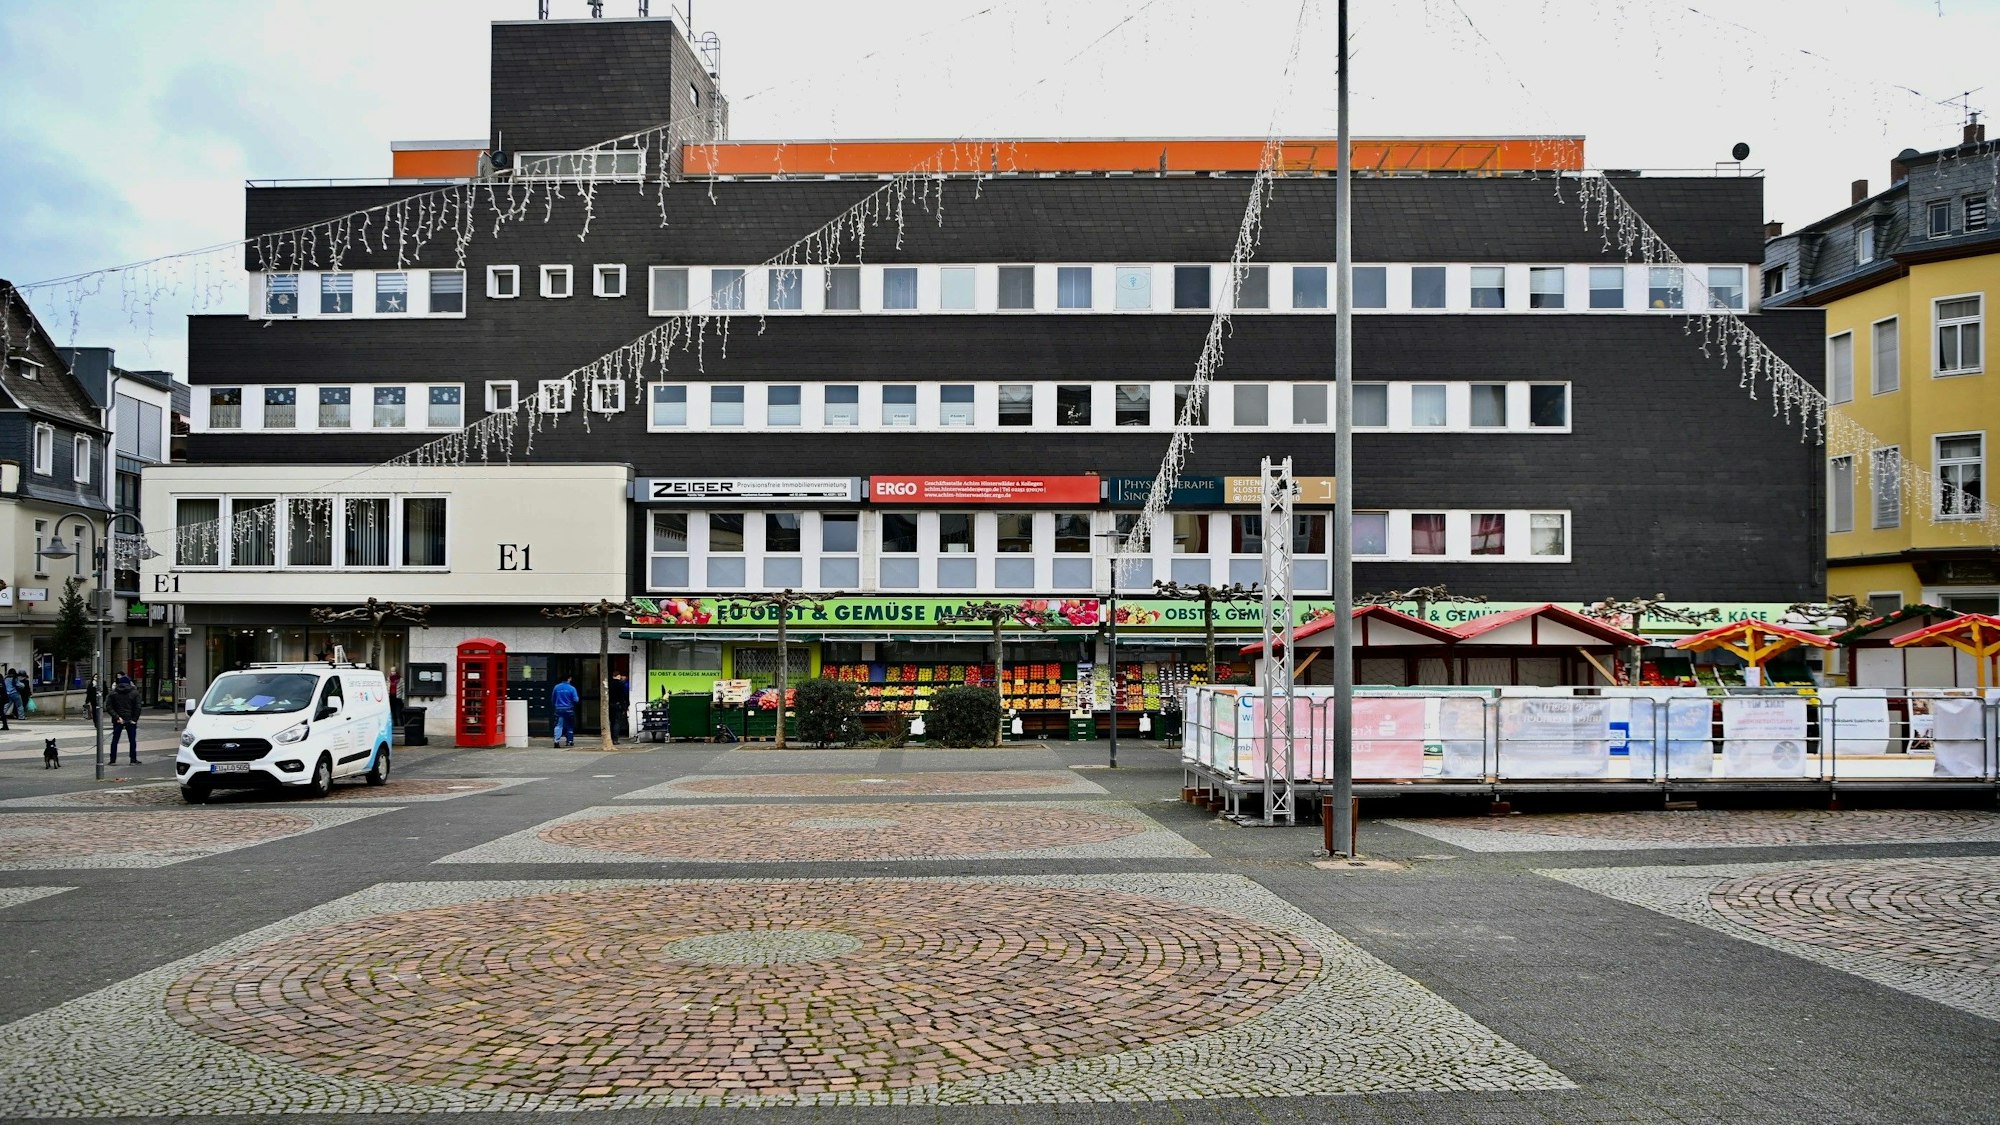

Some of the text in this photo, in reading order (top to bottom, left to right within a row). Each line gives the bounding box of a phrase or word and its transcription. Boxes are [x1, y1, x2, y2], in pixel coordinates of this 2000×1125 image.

[653, 482, 734, 498] ZEIGER
[736, 481, 847, 490] Provisionsfreie Immobilienvermietung
[876, 482, 918, 496] ERGO
[1123, 479, 1215, 490] PHYSITHERAPIE
[497, 544, 533, 570] E1
[153, 574, 181, 592] E1
[717, 601, 1014, 621] EU OBST & GEMÜSE MAT
[1165, 608, 1207, 621] OBST
[1225, 608, 1287, 621] GEMS
[1429, 609, 1440, 621] &
[1446, 606, 1510, 622] GEMÜ
[1728, 607, 1768, 623] KÄSE
